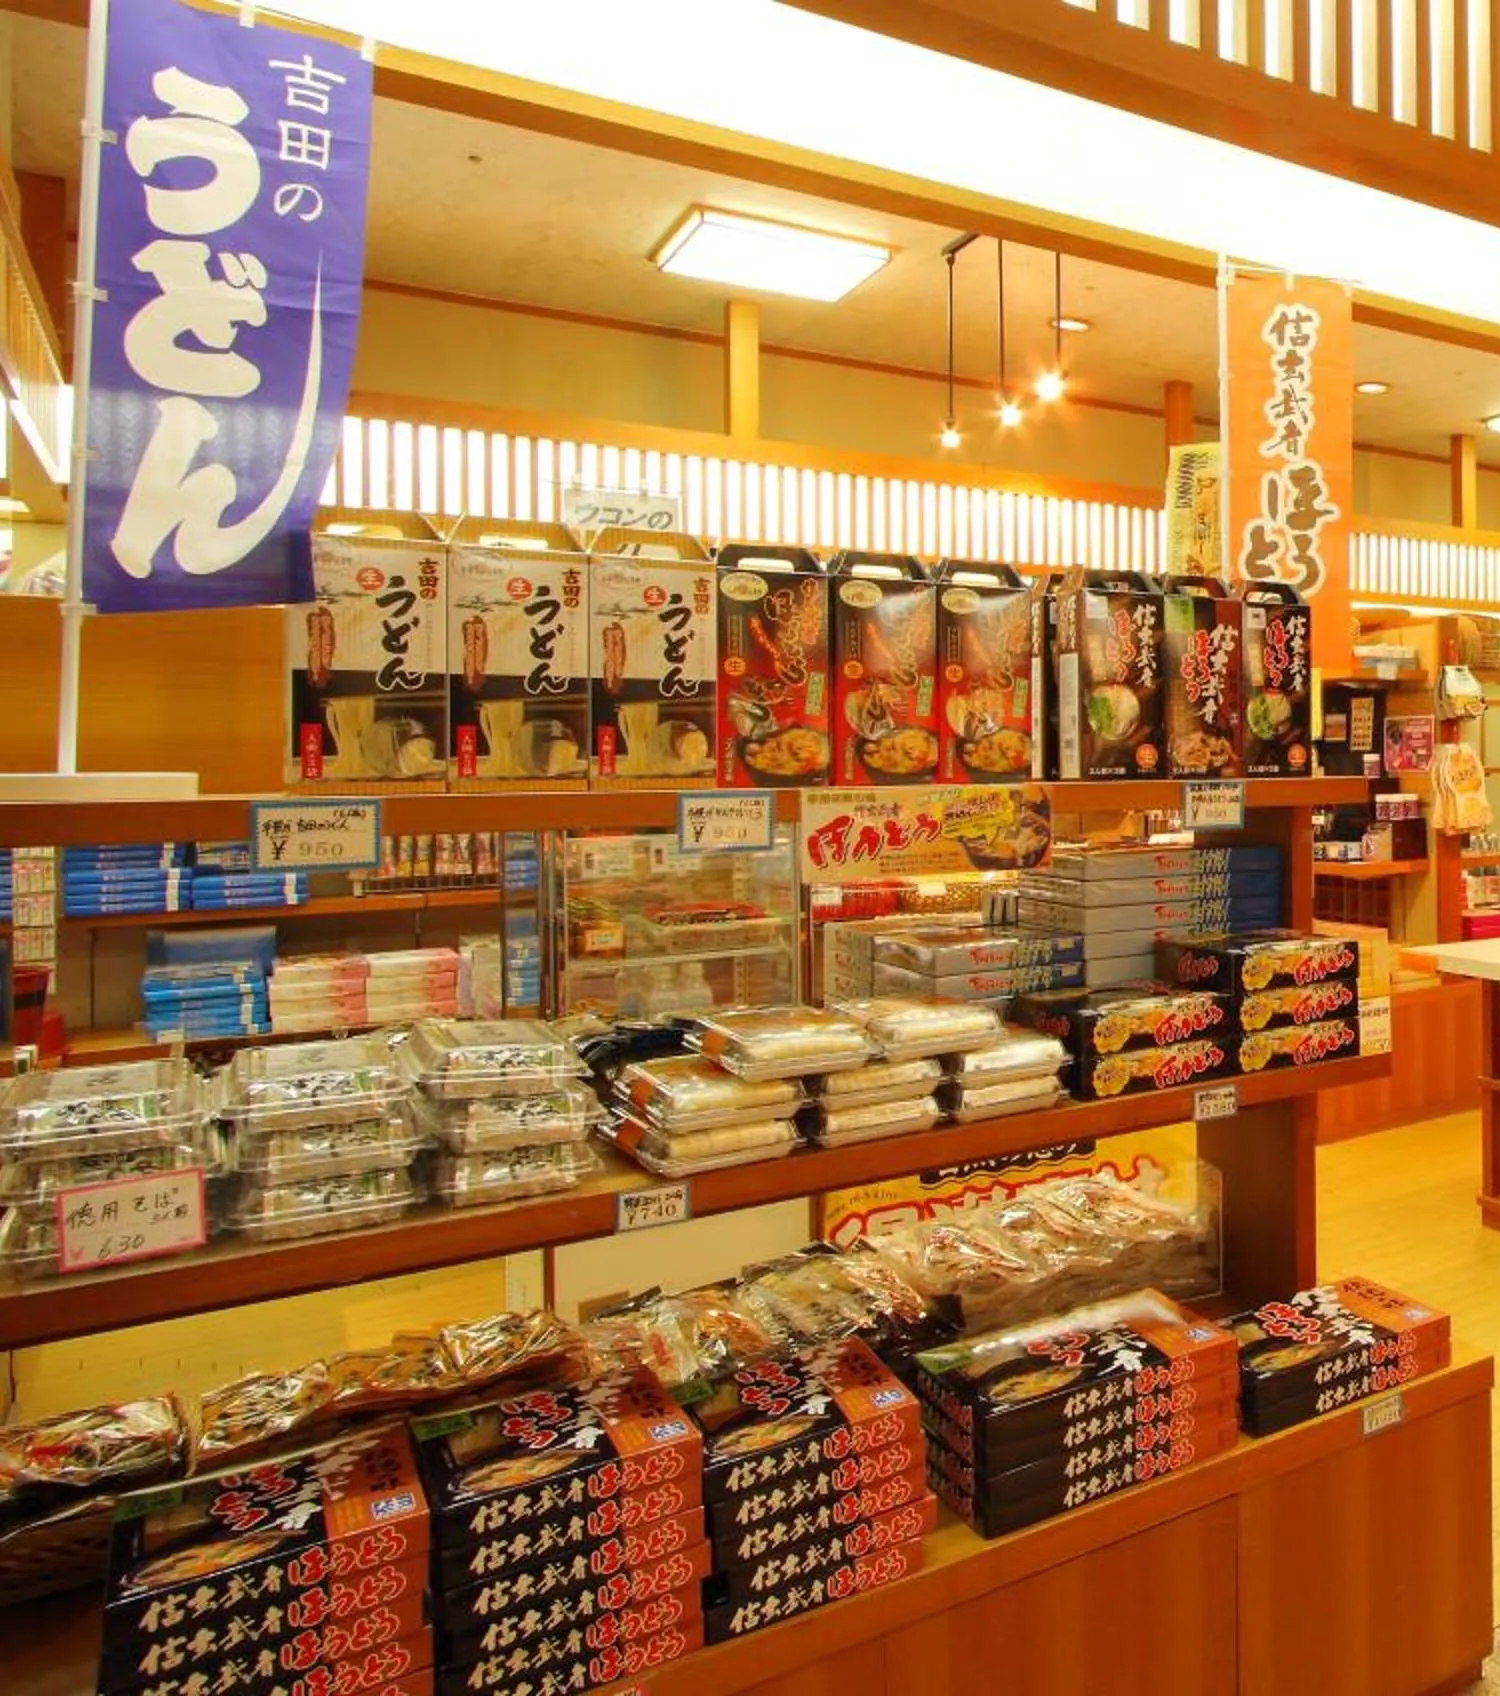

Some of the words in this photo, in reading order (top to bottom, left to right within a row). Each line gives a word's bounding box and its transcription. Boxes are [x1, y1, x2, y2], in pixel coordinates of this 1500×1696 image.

[268, 54, 347, 223] 吉田の
[109, 65, 324, 579] うどん
[417, 557, 440, 600] 吉田の
[375, 575, 426, 691] うどん
[523, 585, 570, 694] うどん
[658, 593, 701, 697] うどん
[298, 841, 344, 857] 950
[98, 1233, 144, 1261] 630
